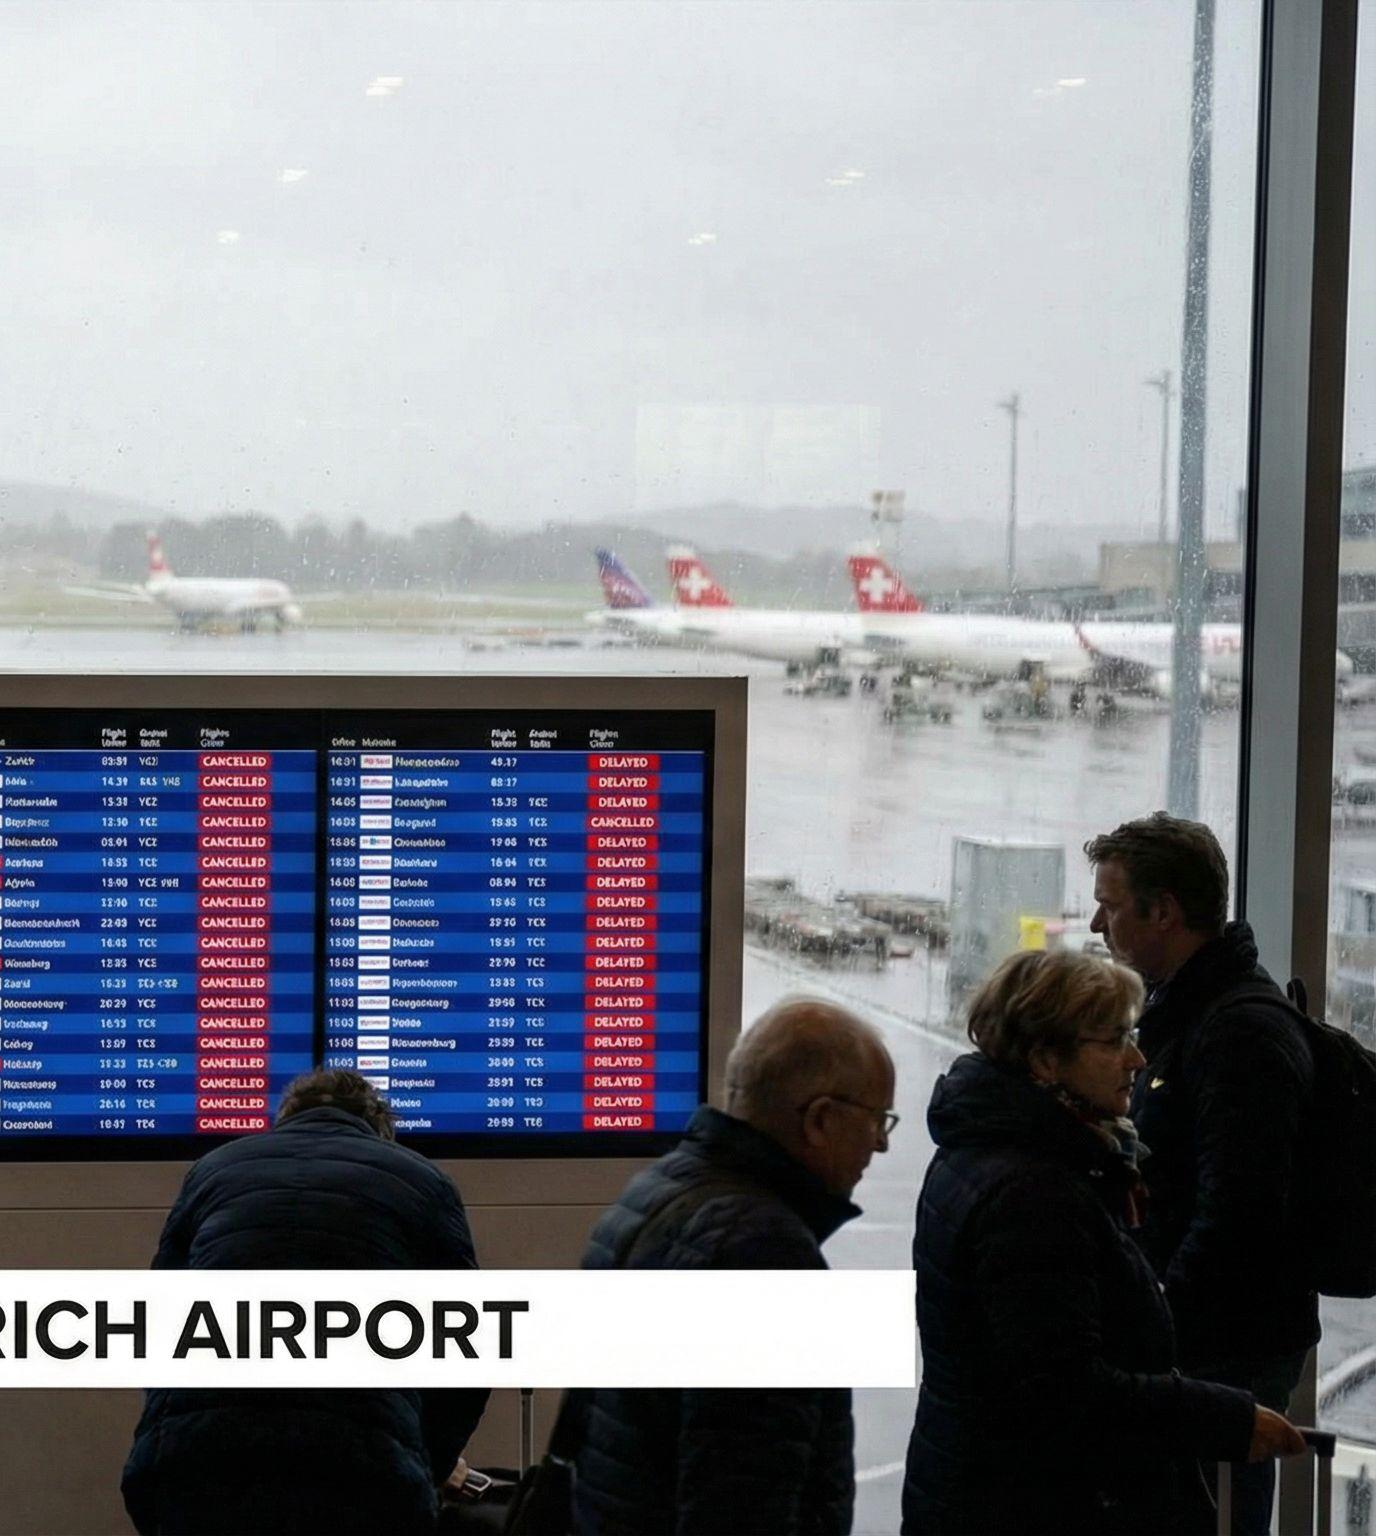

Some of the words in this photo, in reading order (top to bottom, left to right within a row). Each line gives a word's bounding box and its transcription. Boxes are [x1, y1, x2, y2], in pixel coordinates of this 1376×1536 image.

[202, 756, 267, 767] CANCELLED
[202, 776, 267, 787] CANCELLED
[202, 796, 267, 808] CANCELLED
[202, 816, 267, 828] CANCELLED
[202, 836, 266, 848] CANCELLED
[202, 856, 267, 868] CANCELLED
[201, 876, 266, 888] CANCELLED
[201, 896, 266, 908] CANCELLED
[201, 917, 266, 928] CANCELLED
[200, 937, 266, 949] CANCELLED
[200, 957, 266, 969] CANCELLED
[200, 977, 266, 989] CANCELLED
[200, 997, 266, 1009] CANCELLED
[200, 1017, 265, 1029] CANCELLED
[200, 1037, 265, 1049] CANCELLED
[200, 1057, 265, 1069] CANCELLED
[199, 1077, 265, 1089] CANCELLED
[199, 1098, 265, 1109] CANCELLED
[199, 1118, 265, 1129] CANCELLED
